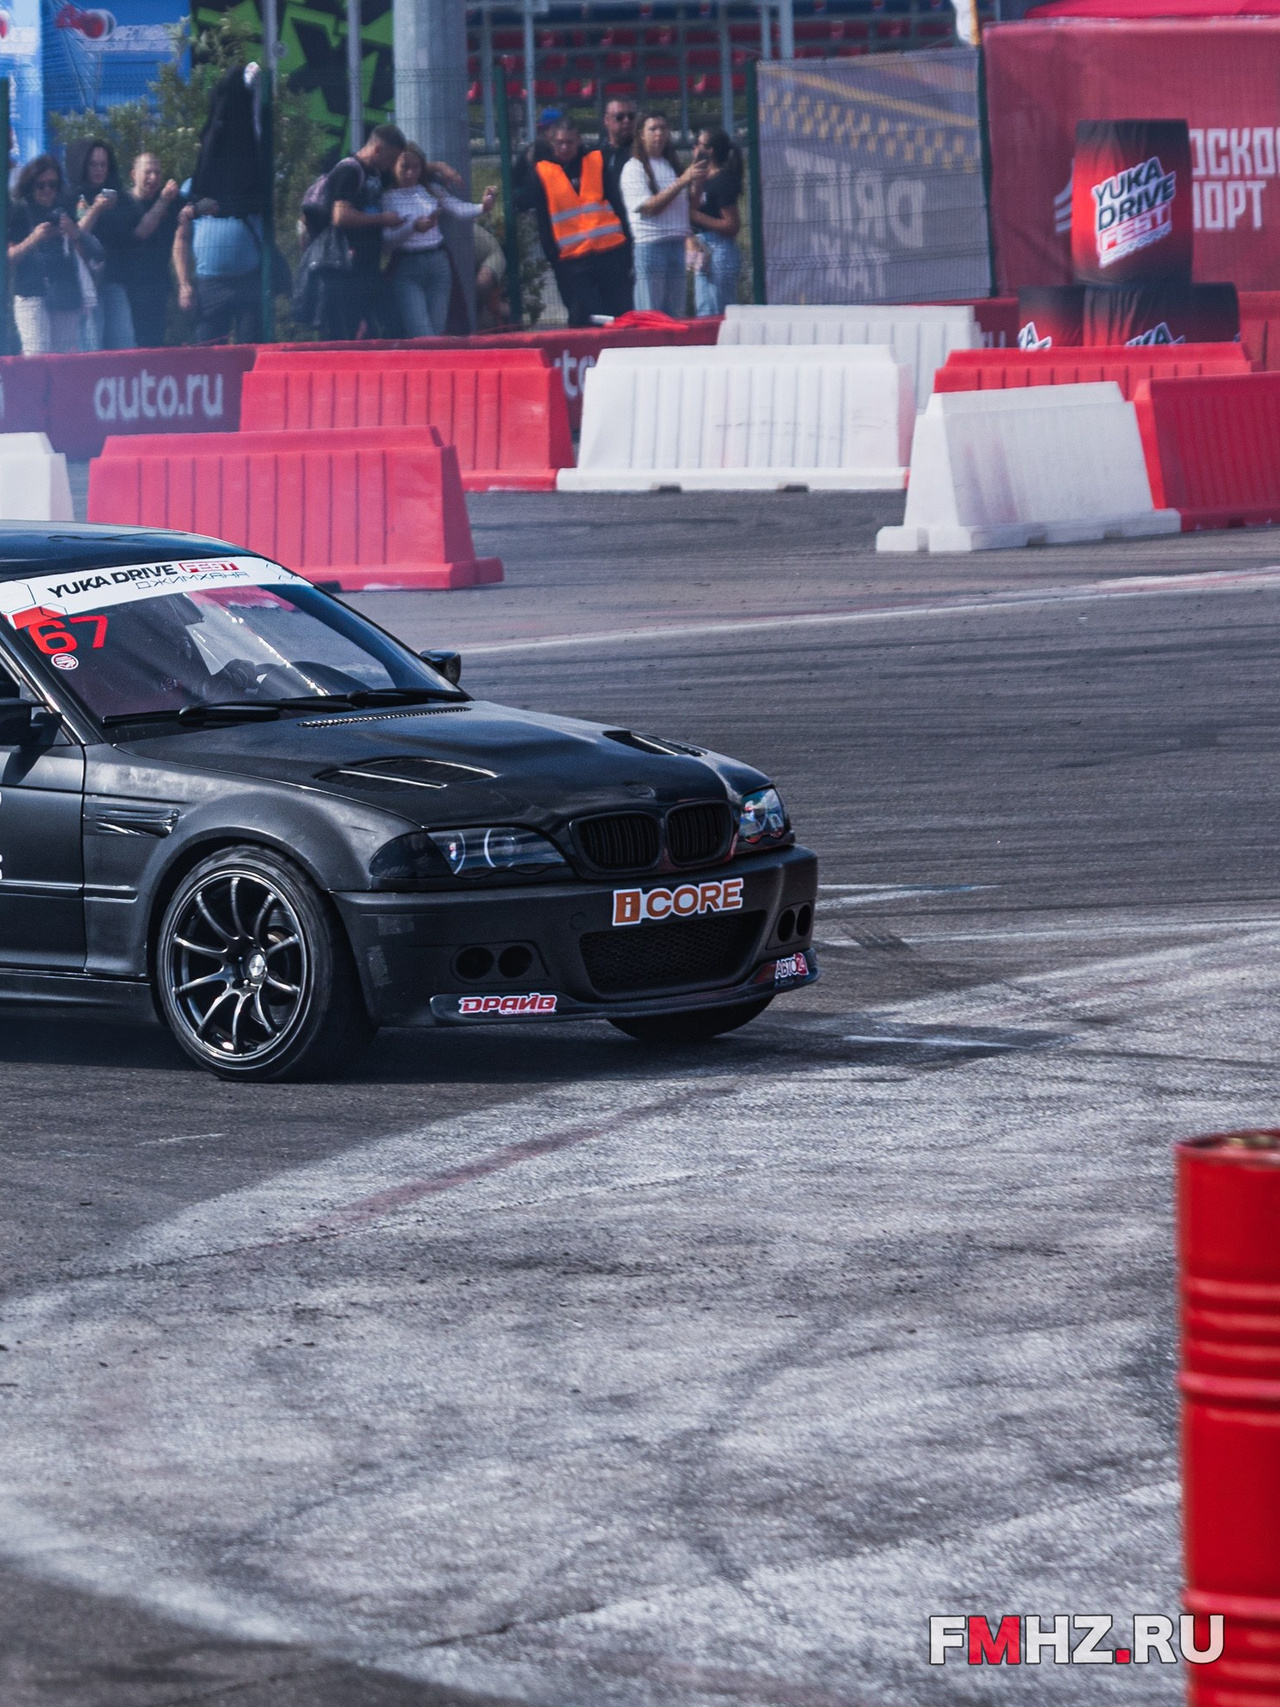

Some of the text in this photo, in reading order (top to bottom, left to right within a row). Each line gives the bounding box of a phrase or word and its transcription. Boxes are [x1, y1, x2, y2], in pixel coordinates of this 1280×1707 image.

[1189, 127, 1280, 177] ОСКО
[1095, 160, 1161, 207] YUKA
[1099, 174, 1176, 232] DRIVE
[1101, 203, 1170, 252] FEST
[93, 369, 224, 421] auto.ru
[47, 561, 239, 598] YUKA DRIVE FEST
[28, 615, 108, 655] 67
